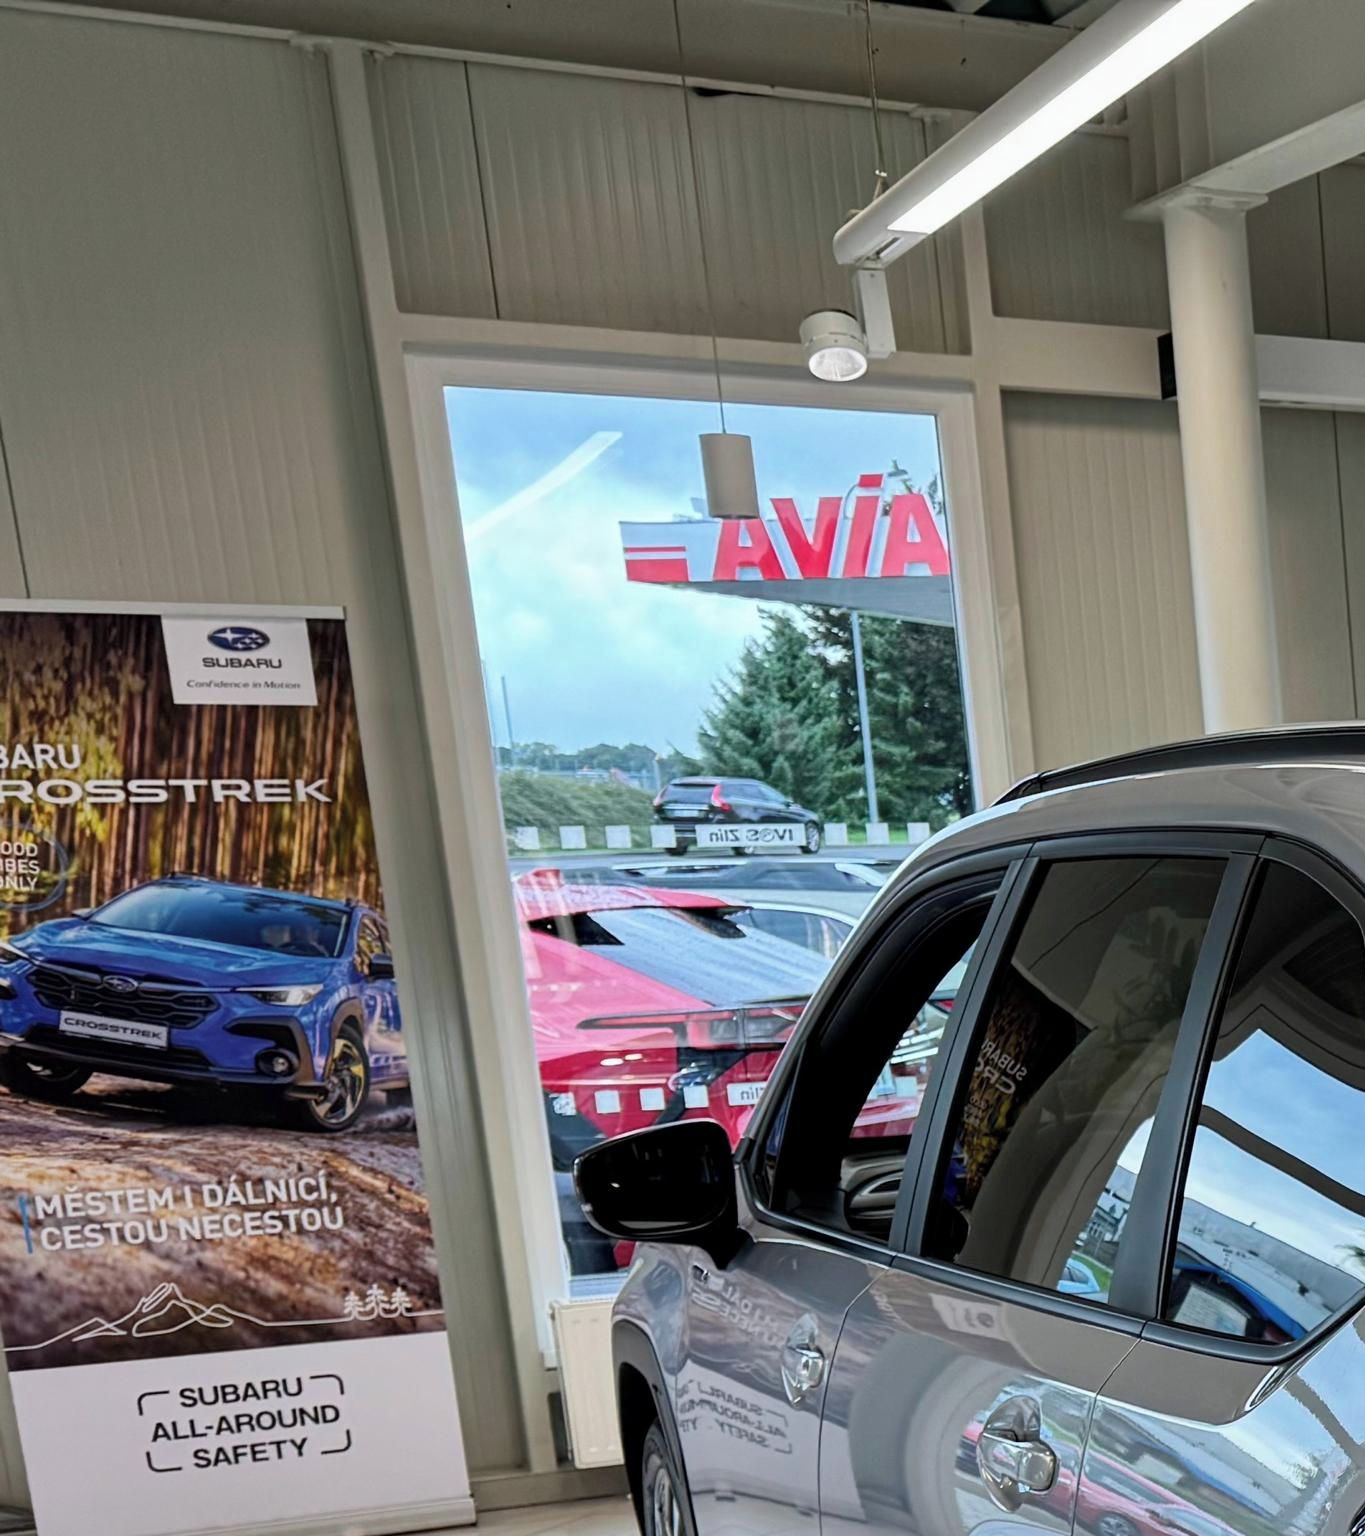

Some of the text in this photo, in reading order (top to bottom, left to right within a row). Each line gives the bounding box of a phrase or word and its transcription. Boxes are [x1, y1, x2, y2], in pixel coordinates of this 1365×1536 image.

[202, 657, 282, 669] SUBARU
[186, 680, 250, 689] Confidence
[263, 681, 301, 689] Motion
[64, 1017, 163, 1040] CROSSTREK
[35, 1169, 338, 1220] MĚSTEM I DÁLNICÍ,
[40, 1206, 344, 1251] CESTOU NECESTOU
[179, 1377, 303, 1408] SUBARU
[152, 1404, 340, 1442] ALL-AROUND
[193, 1437, 308, 1469] SAFETY
